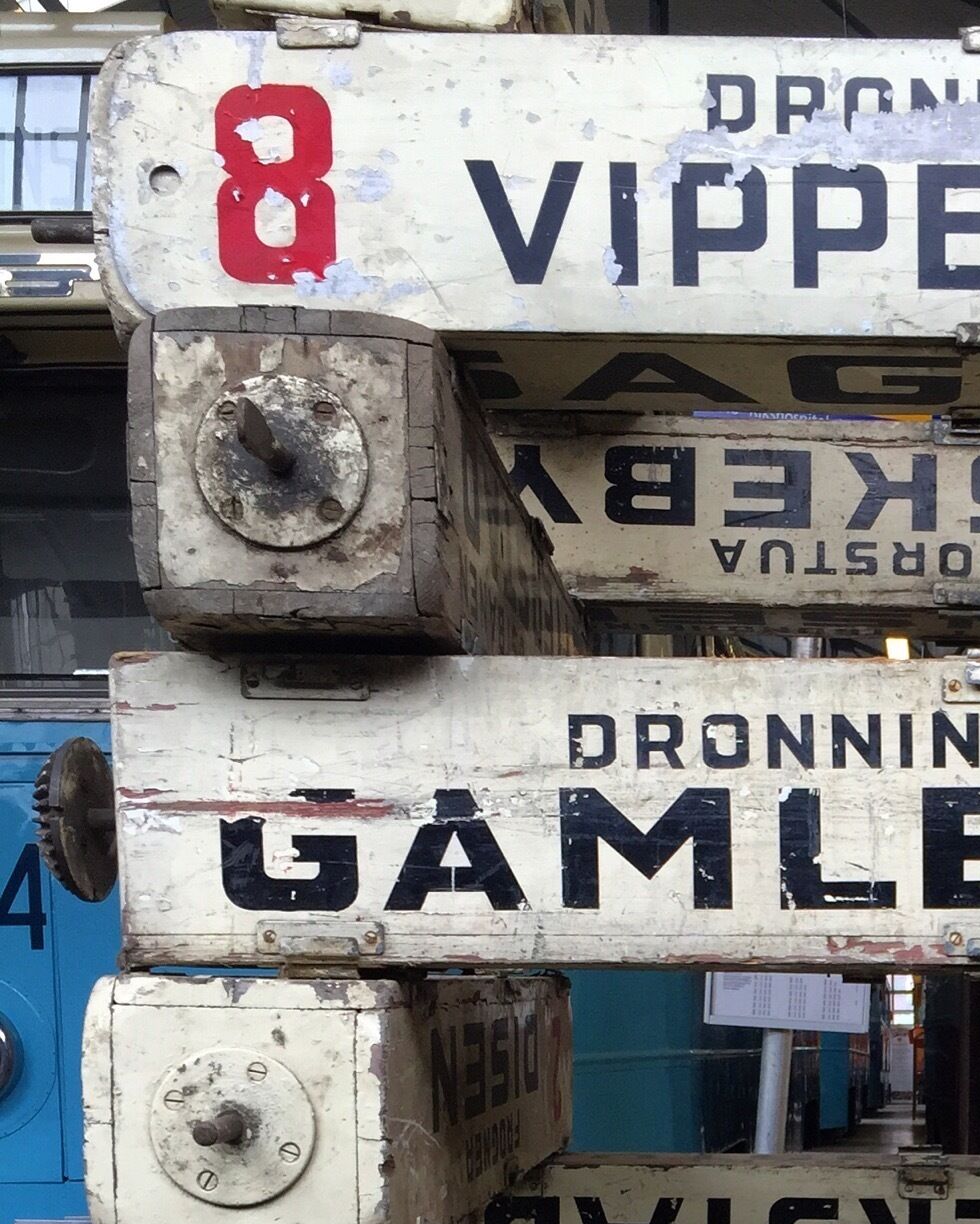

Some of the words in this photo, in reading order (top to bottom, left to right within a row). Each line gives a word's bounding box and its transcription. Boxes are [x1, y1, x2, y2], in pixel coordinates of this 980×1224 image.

[214, 83, 337, 285] 8
[0, 843, 46, 950] 4
[430, 1013, 539, 1133] DISEN
